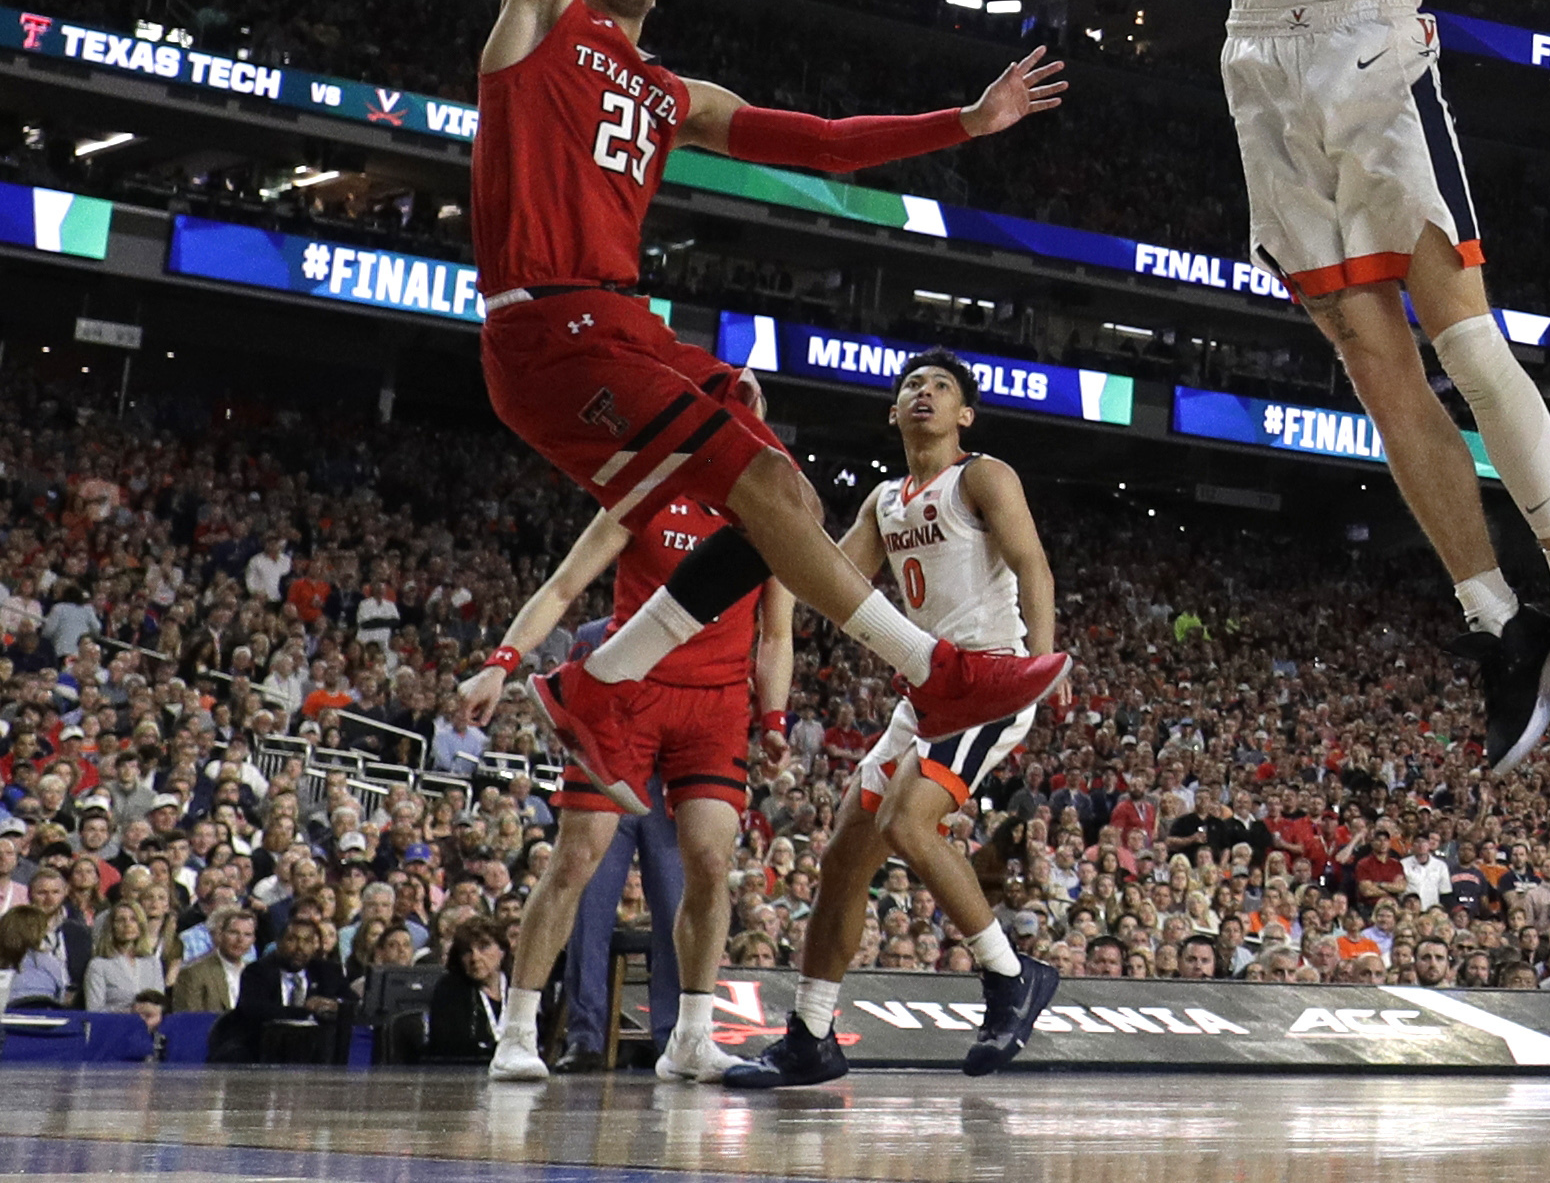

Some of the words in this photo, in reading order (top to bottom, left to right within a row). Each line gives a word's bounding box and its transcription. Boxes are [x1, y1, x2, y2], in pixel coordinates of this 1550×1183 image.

[61, 24, 181, 79] TEXAS
[188, 51, 282, 100] TECH
[576, 44, 644, 97] TEXAS
[593, 90, 657, 186] 25
[1135, 242, 1226, 288] FINAL
[807, 336, 1049, 401] MINNOLIS
[662, 529, 705, 552] TEX
[903, 557, 926, 609] 0
[1288, 1007, 1443, 1036] ACC
